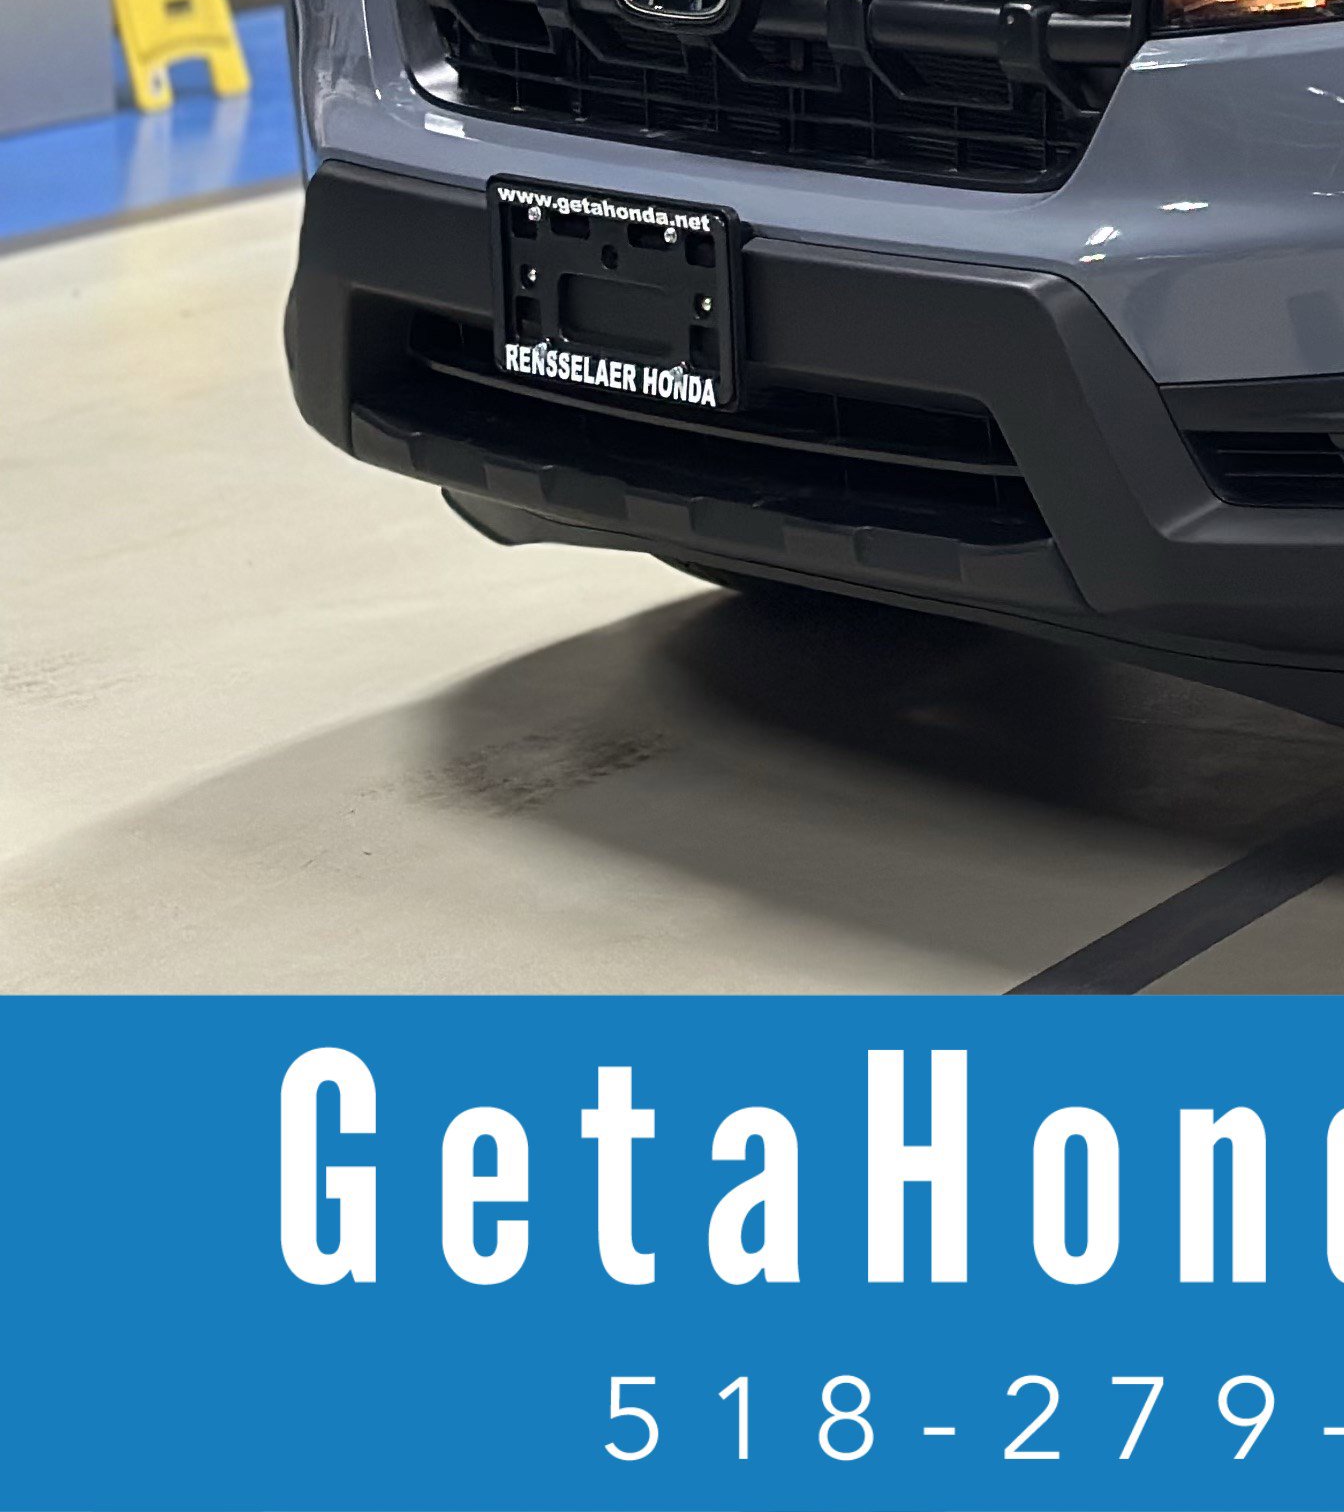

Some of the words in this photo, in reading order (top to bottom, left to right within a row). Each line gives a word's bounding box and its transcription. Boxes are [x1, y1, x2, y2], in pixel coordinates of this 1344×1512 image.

[498, 187, 710, 232] www.getahonda.net
[505, 343, 637, 393] RENSSELAER
[642, 366, 717, 408] HONDA
